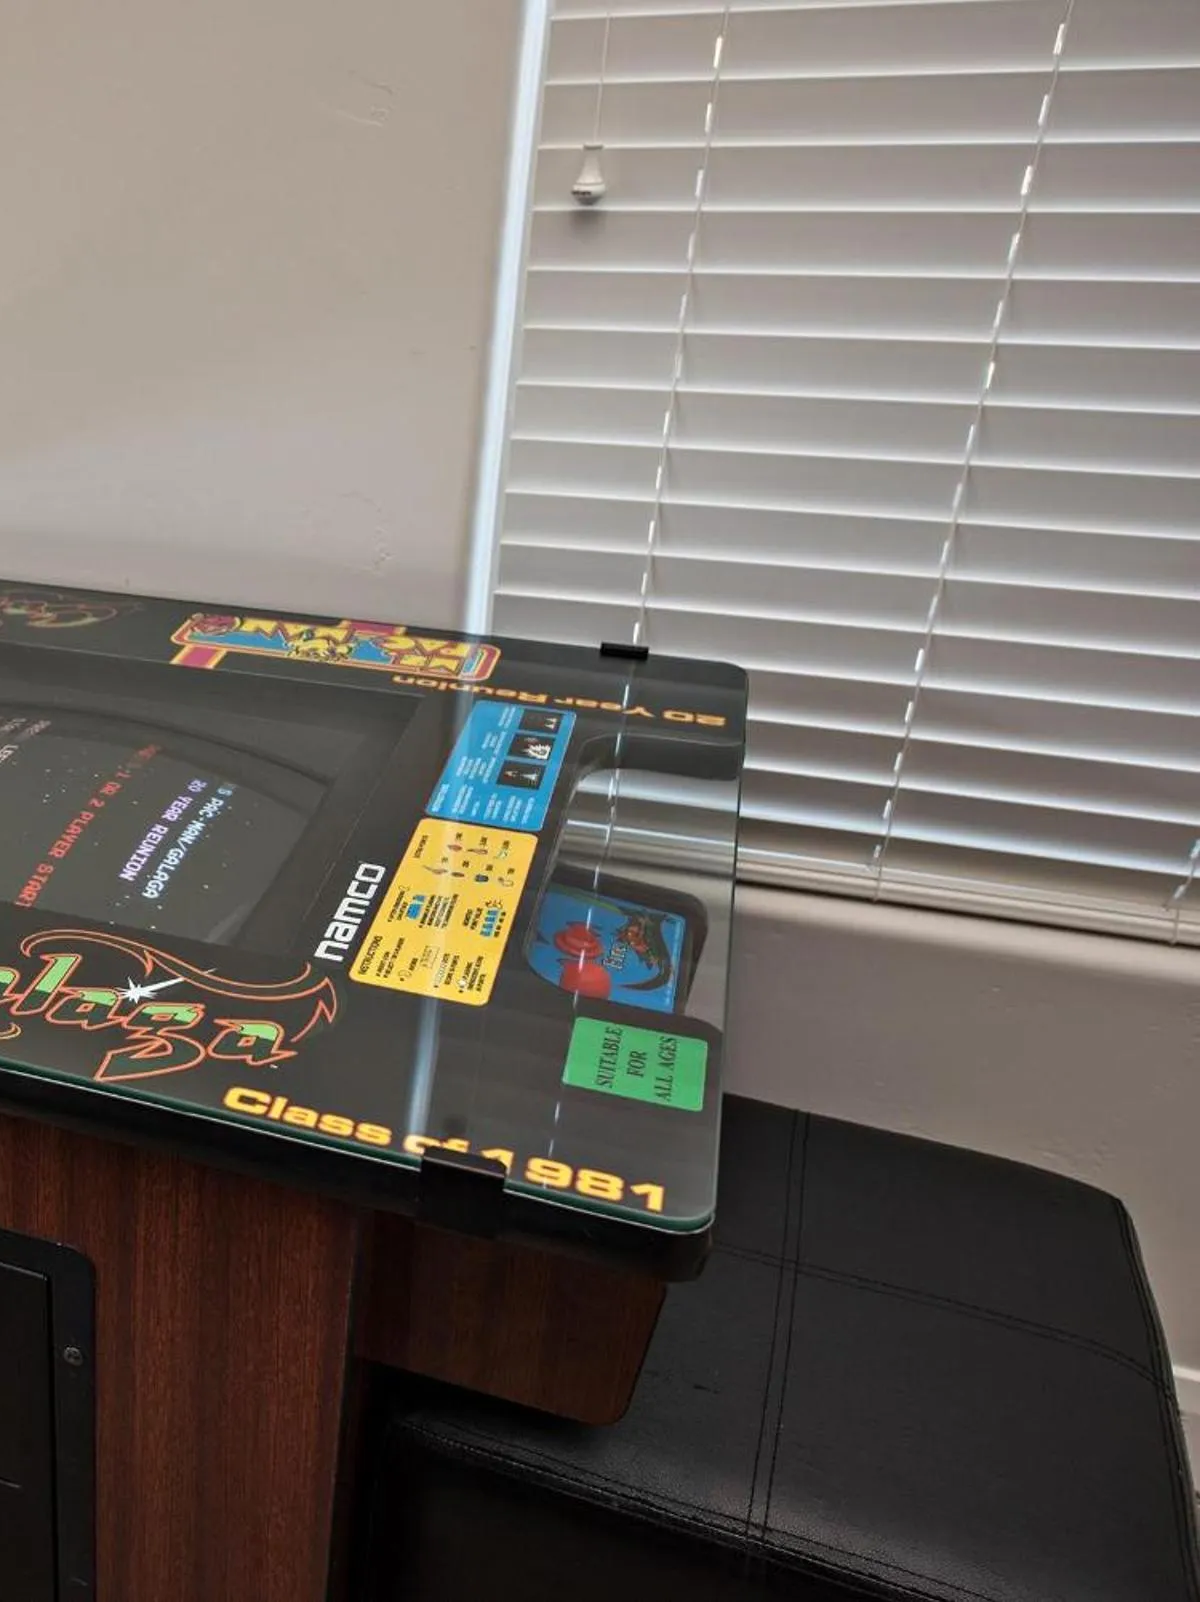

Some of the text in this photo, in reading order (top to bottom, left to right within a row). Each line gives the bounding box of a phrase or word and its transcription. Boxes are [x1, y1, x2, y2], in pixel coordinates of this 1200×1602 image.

[392, 673, 727, 727] 20 Year Reunion
[48, 810, 96, 859] PLAYER
[89, 798, 106, 808] 2
[117, 778, 209, 882] 20 YEAR REUNION
[313, 862, 387, 962] namco
[595, 1026, 624, 1089] SUITABLE
[626, 1050, 648, 1078] FOR
[653, 1036, 678, 1102] ALL AGES
[222, 1086, 393, 1147] Class
[481, 1147, 666, 1213] 1981
